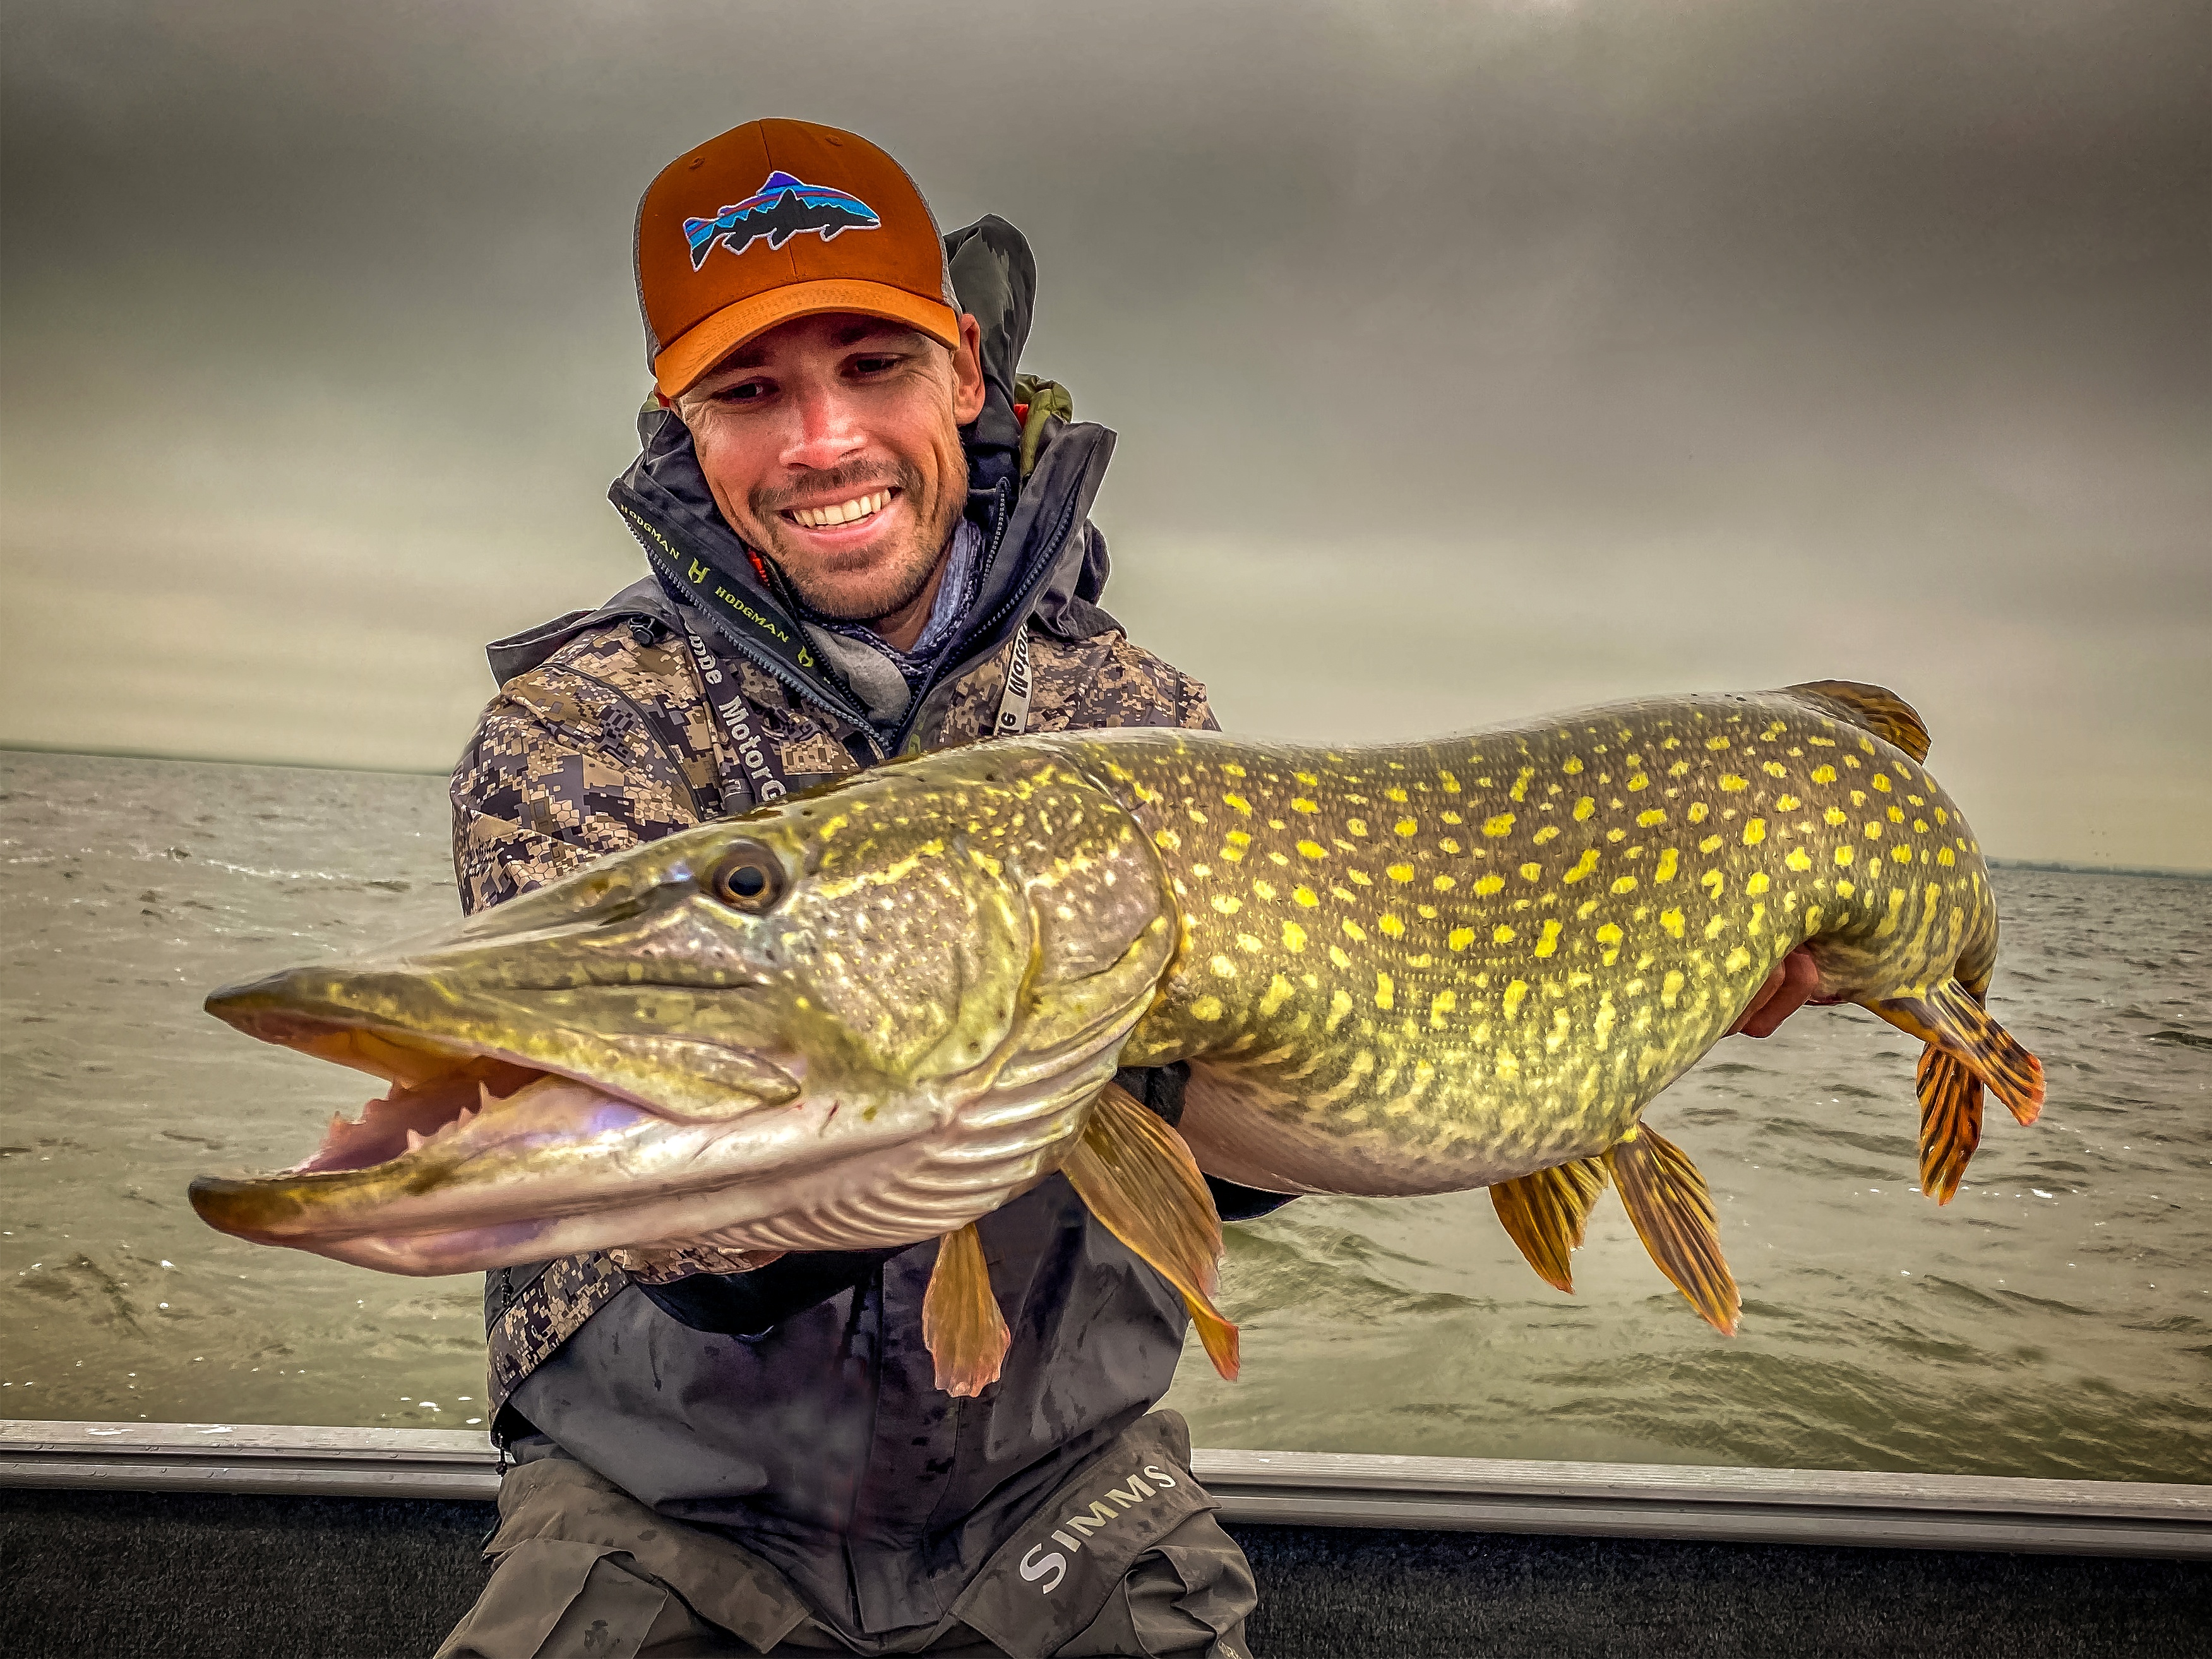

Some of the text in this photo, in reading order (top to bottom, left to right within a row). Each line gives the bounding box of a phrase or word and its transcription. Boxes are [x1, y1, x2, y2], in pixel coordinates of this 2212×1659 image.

[621, 503, 680, 560] HODGMAN
[715, 585, 790, 643] HODGMAN
[1020, 1465, 1176, 1595] SIMMS
